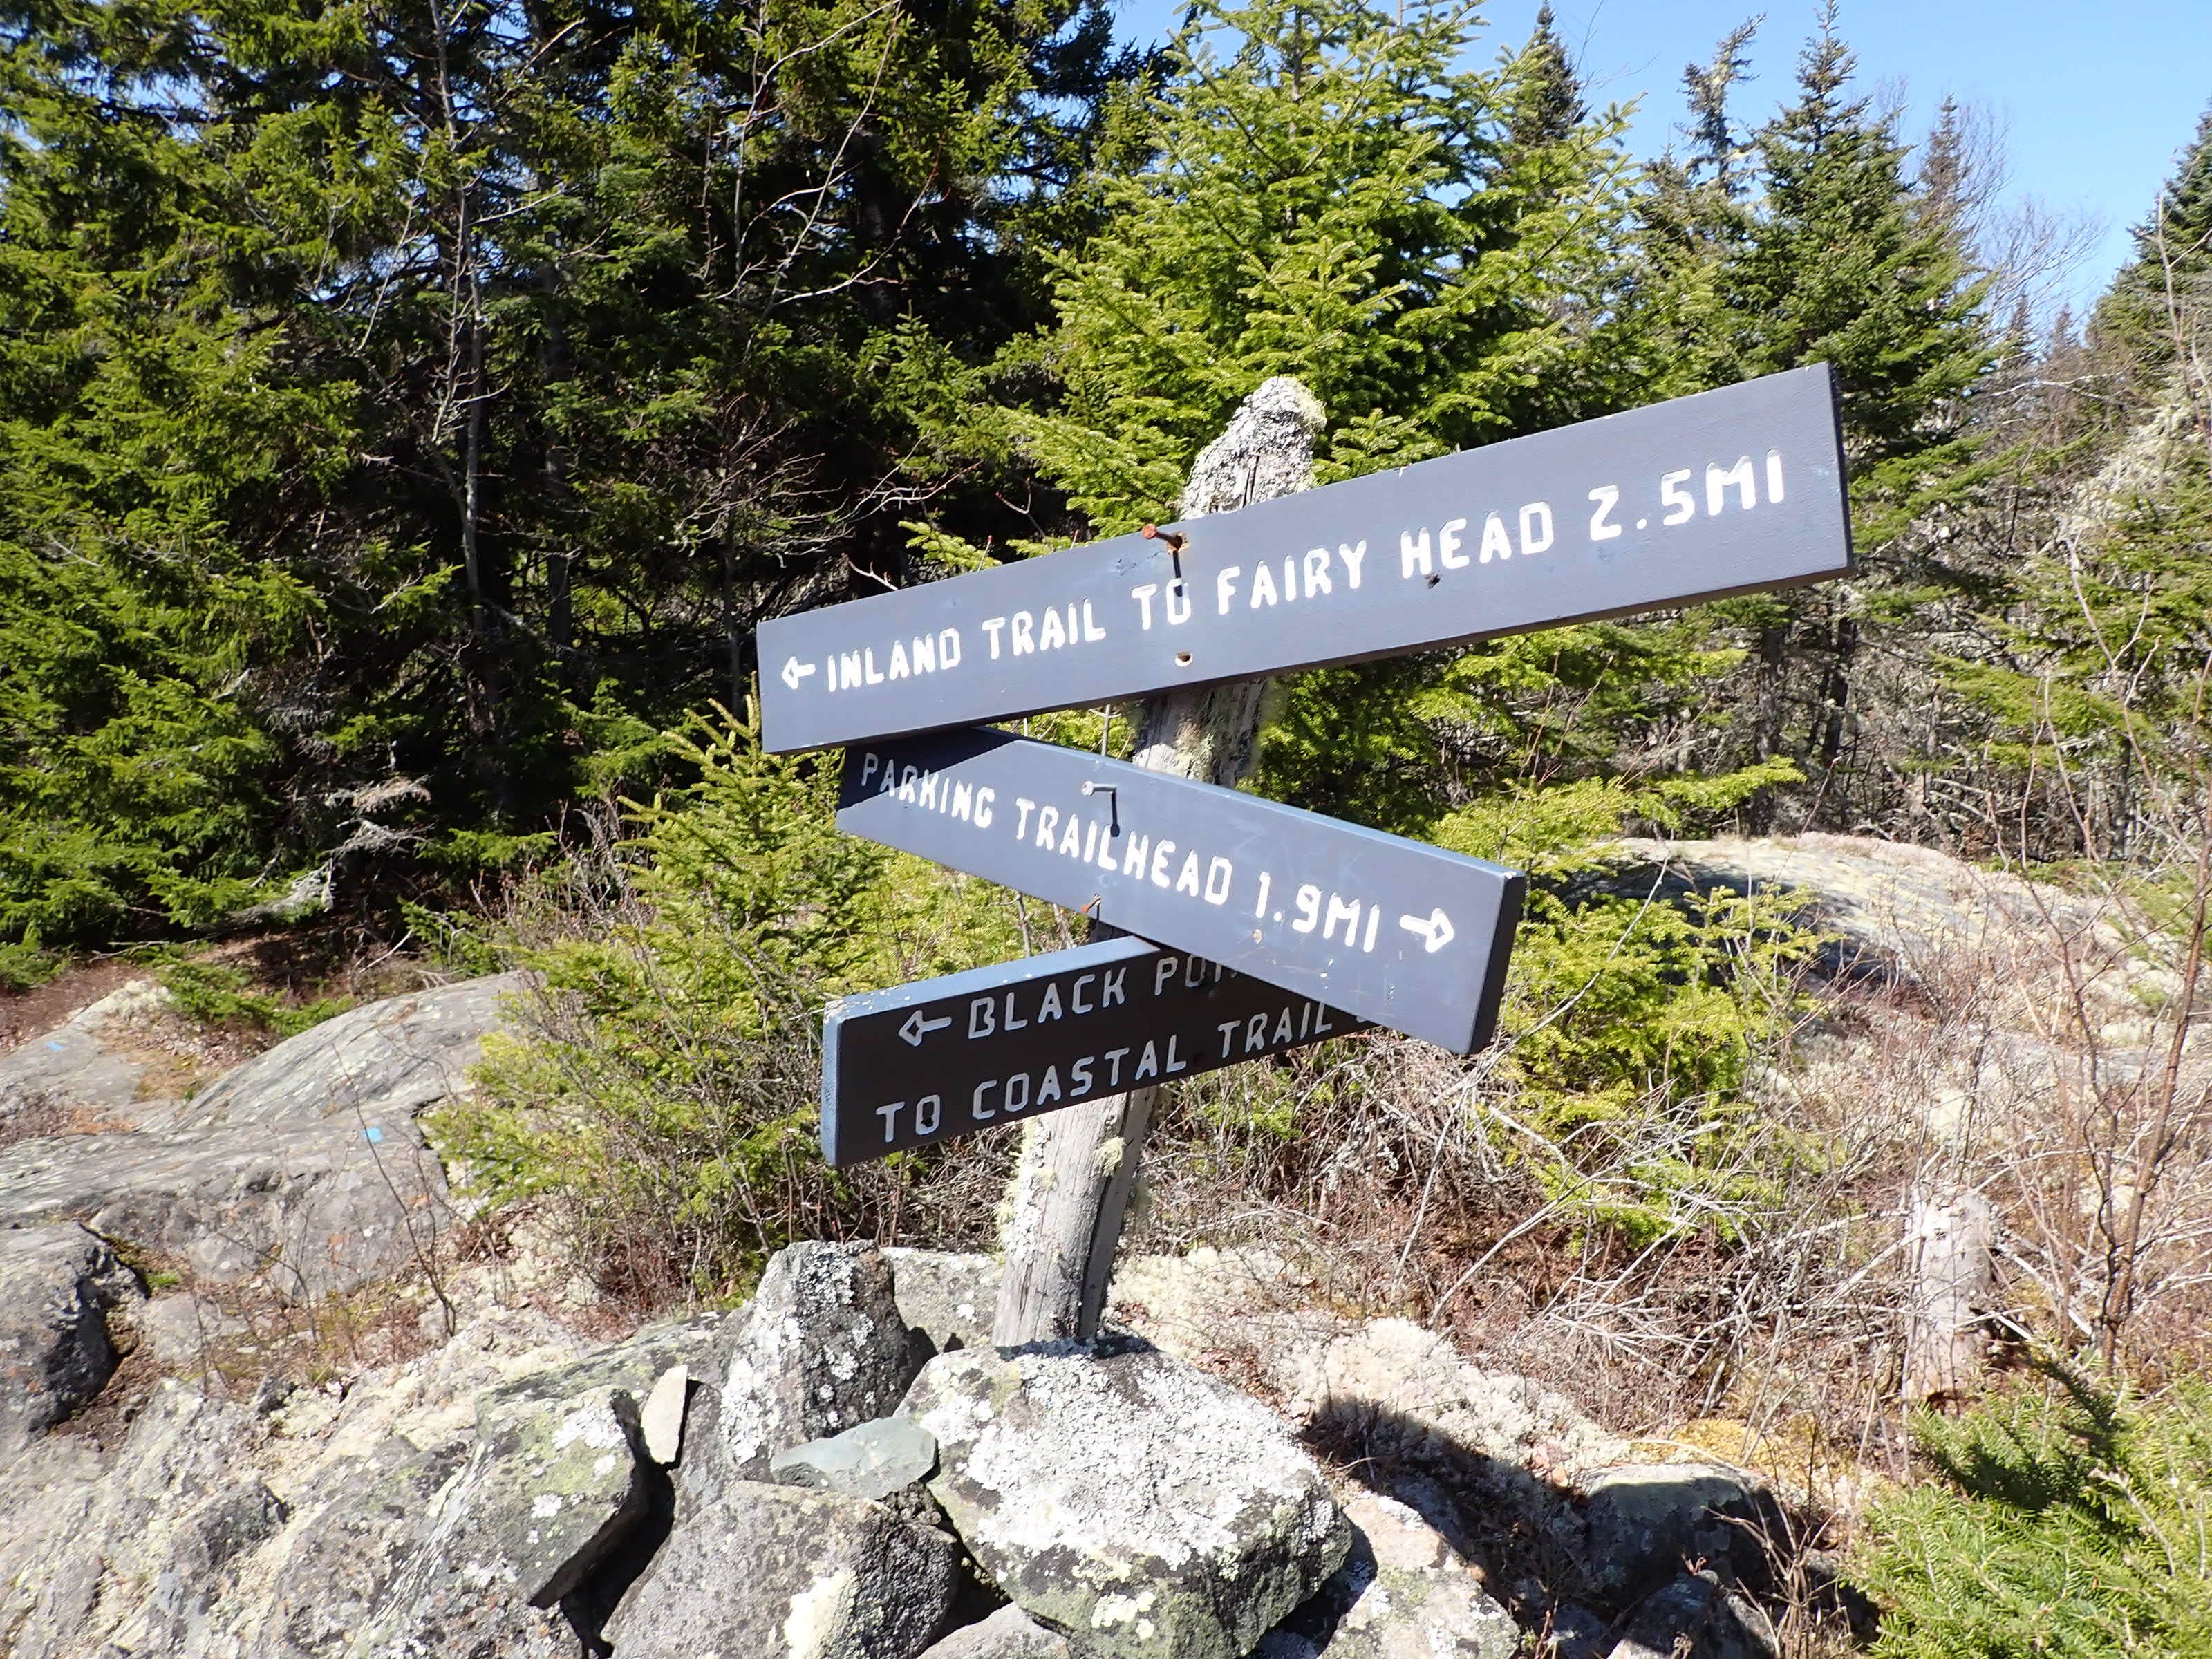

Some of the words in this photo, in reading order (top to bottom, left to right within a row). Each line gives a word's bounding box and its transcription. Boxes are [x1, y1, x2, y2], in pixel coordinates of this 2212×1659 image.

[827, 628, 961, 692] INLAND
[982, 598, 1106, 659] TRAIL
[1131, 577, 1192, 630] TO
[1217, 540, 1367, 616] FAIRY
[1400, 501, 1554, 579] HEAD
[861, 753, 995, 828] PARKING
[1015, 798, 1232, 905] TRAILHEAD
[877, 1094, 940, 1142] TO
[973, 1035, 1187, 1121] COASTAL
[1218, 1002, 1333, 1058] TRAIL
[968, 967, 1127, 1039] BLACK
